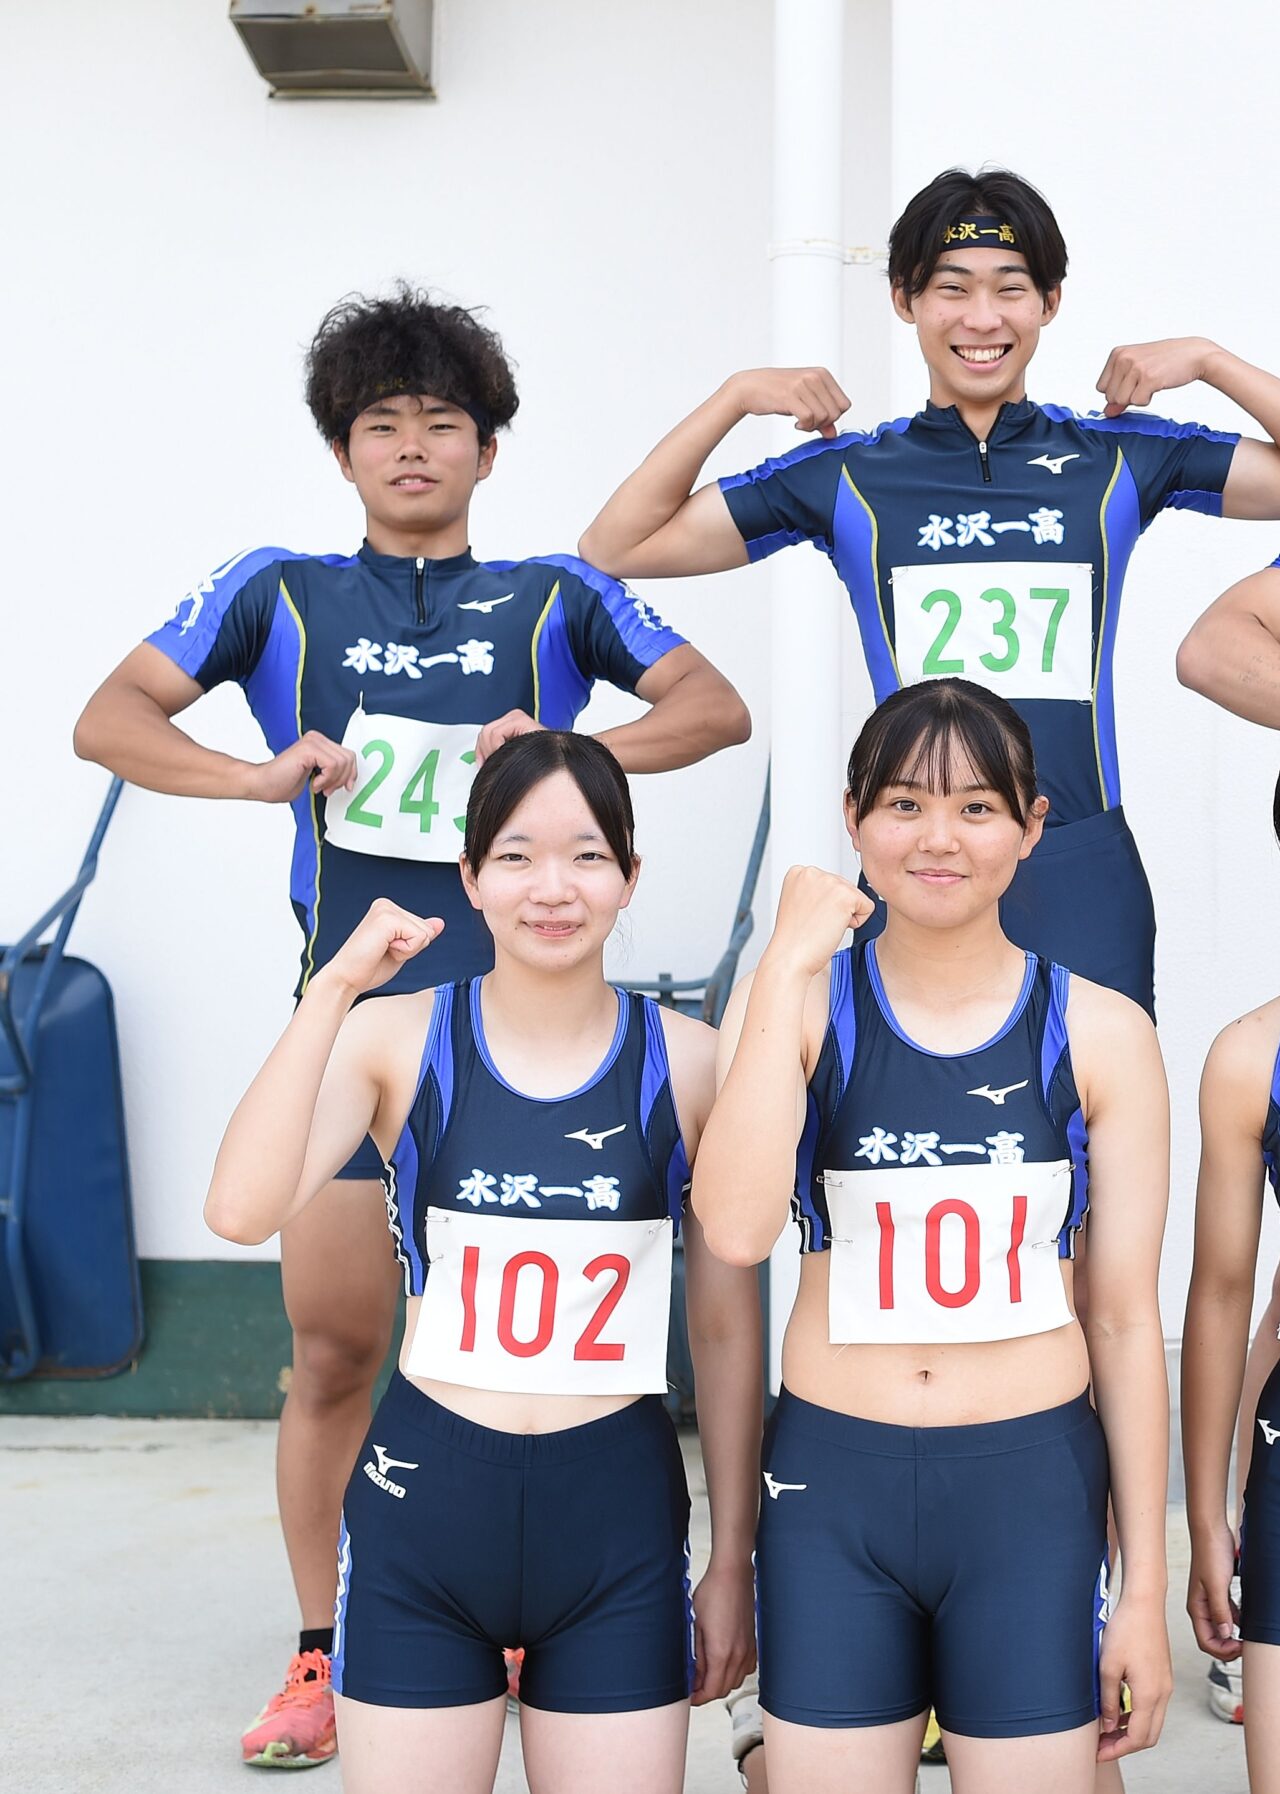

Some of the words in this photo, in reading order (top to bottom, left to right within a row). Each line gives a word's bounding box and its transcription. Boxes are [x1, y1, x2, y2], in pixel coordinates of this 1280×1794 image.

[943, 222, 1016, 244] 水沢一高
[916, 507, 1064, 551] 水沢一高
[920, 587, 1070, 676] 237
[342, 637, 495, 679] 水沢一高
[344, 739, 477, 833] 24
[854, 1127, 1025, 1166] 水沢一高
[456, 1168, 621, 1211] 水沢一高
[875, 1195, 1028, 1309] 101
[459, 1245, 631, 1361] 102
